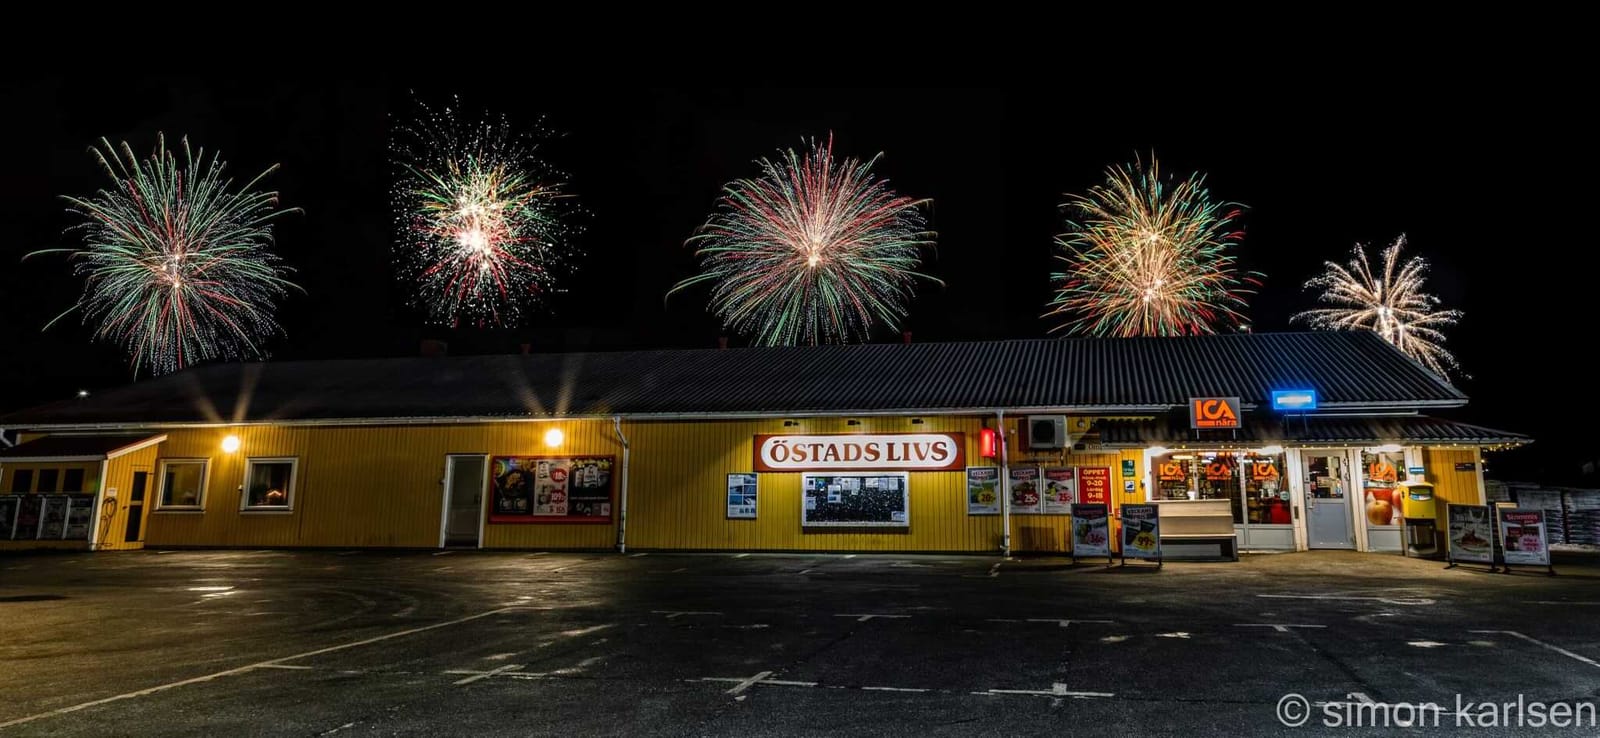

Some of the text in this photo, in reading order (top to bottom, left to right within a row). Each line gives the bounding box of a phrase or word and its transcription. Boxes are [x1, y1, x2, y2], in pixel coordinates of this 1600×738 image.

[1195, 399, 1237, 420] ICA
[1215, 418, 1237, 427] nära
[770, 440, 949, 463] ÖSTADS LIVS
[1160, 463, 1184, 476] ICA
[1206, 463, 1230, 476] ICA
[1253, 463, 1278, 476] ICA
